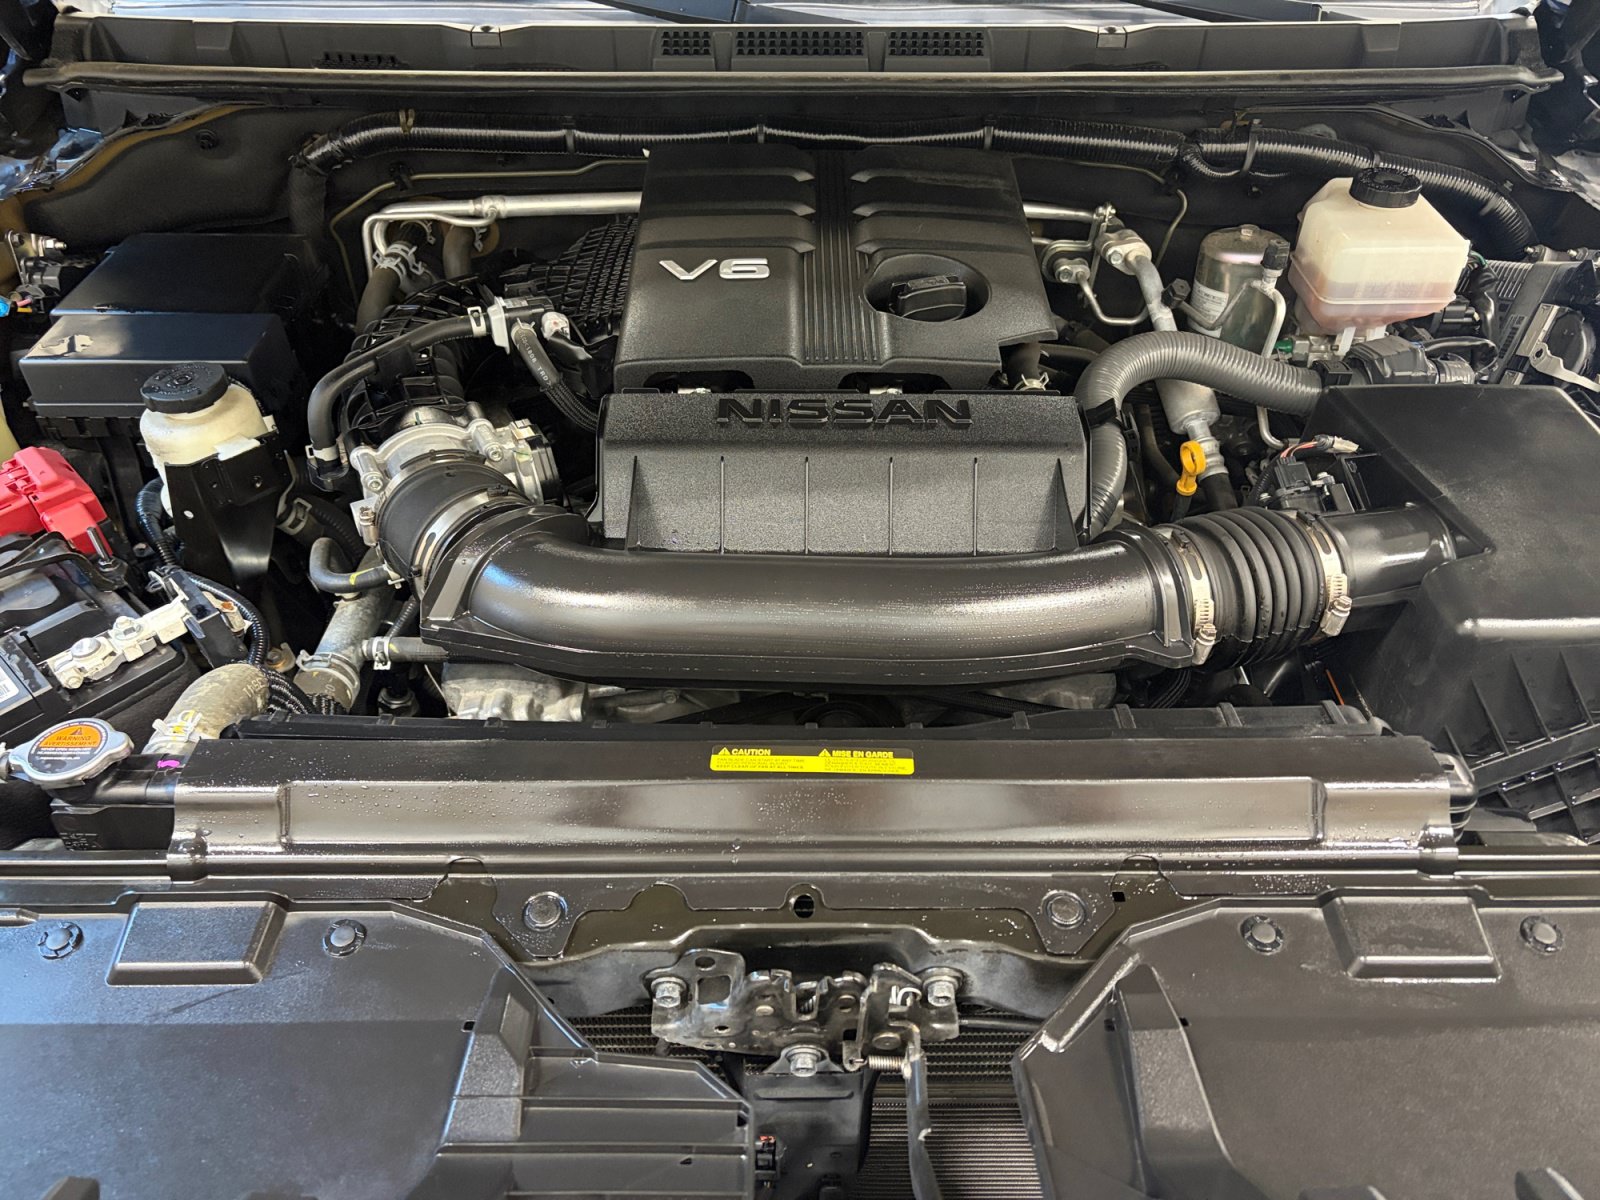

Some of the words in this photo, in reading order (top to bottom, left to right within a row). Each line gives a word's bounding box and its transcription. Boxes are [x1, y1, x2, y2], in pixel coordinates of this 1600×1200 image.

[659, 257, 771, 281] V6
[715, 398, 974, 425] NISSAN
[731, 748, 771, 756] CAUTION
[832, 749, 851, 758] MISE
[852, 750, 864, 758] EN
[865, 750, 894, 759] GARDE
